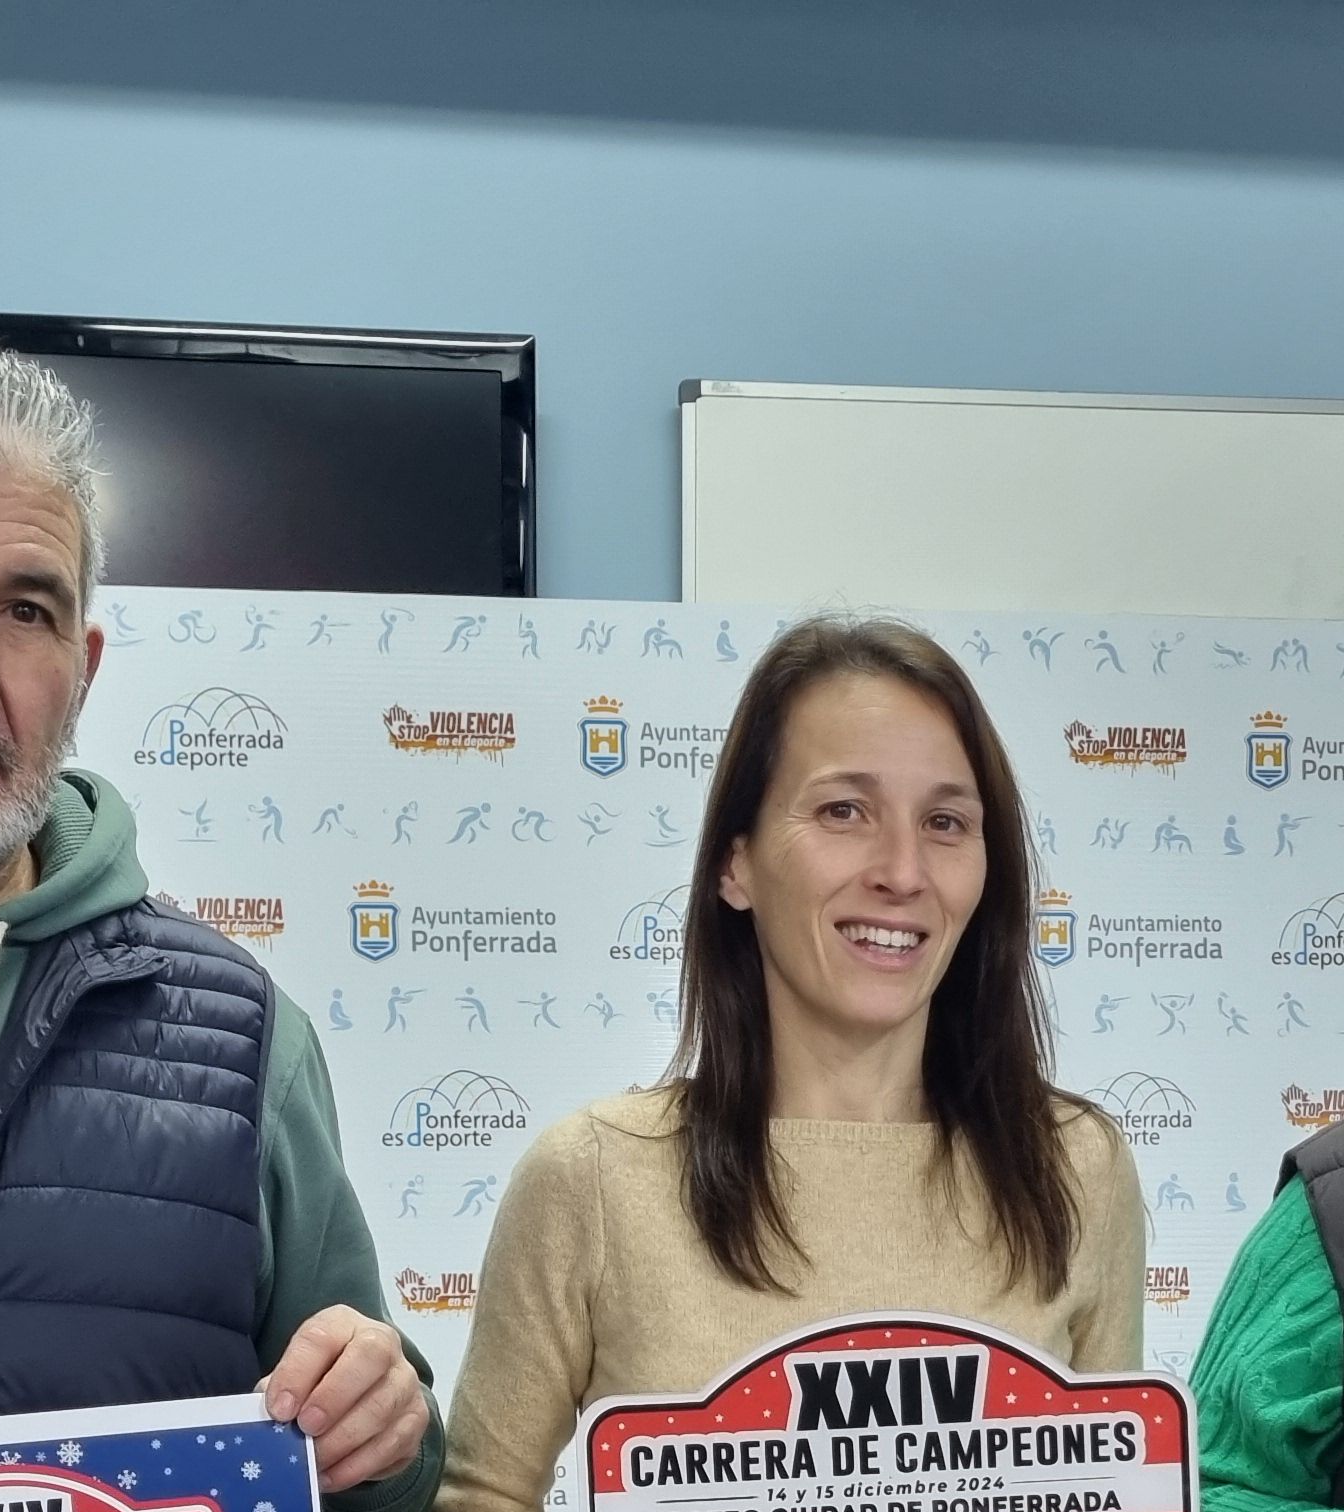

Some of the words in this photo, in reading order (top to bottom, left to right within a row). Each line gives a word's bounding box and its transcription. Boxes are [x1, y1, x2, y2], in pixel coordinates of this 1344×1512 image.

[398, 725, 429, 740] STOP
[430, 712, 514, 734] VIOLENCIA
[170, 720, 283, 749] Ponferrada
[437, 736, 449, 746] en
[452, 735, 461, 746] el
[464, 735, 505, 749] deporte
[1108, 727, 1186, 749] VIOLENCIA
[1078, 740, 1107, 754] STOP
[1114, 750, 1125, 761] en
[1128, 750, 1137, 760] el
[1139, 750, 1178, 763] deporte
[134, 749, 157, 765] es
[160, 749, 248, 770] deporte
[197, 898, 283, 919] VIOLENCIA
[412, 907, 556, 930] Ayuntamiento
[232, 921, 273, 935] deporte
[1089, 914, 1223, 937] Ayuntamiento
[412, 930, 557, 960] Ponferrada
[610, 944, 630, 960] es
[1088, 937, 1223, 966] Ponferrada
[1272, 950, 1292, 965] es
[417, 1102, 526, 1128] Ponferrada
[1295, 1103, 1322, 1116] STOP
[383, 1132, 404, 1147] es
[408, 1129, 492, 1150] deporte
[411, 1288, 440, 1301] STOP
[796, 1354, 981, 1431] XXIV
[630, 1438, 816, 1487] CARRERA
[832, 1434, 880, 1476] DE
[895, 1420, 1136, 1473] CAMPEONES
[767, 1488, 787, 1502] 14
[795, 1487, 808, 1504] y
[816, 1486, 834, 1499] 15
[844, 1480, 948, 1498] diciembre
[957, 1477, 1005, 1492] 2024
